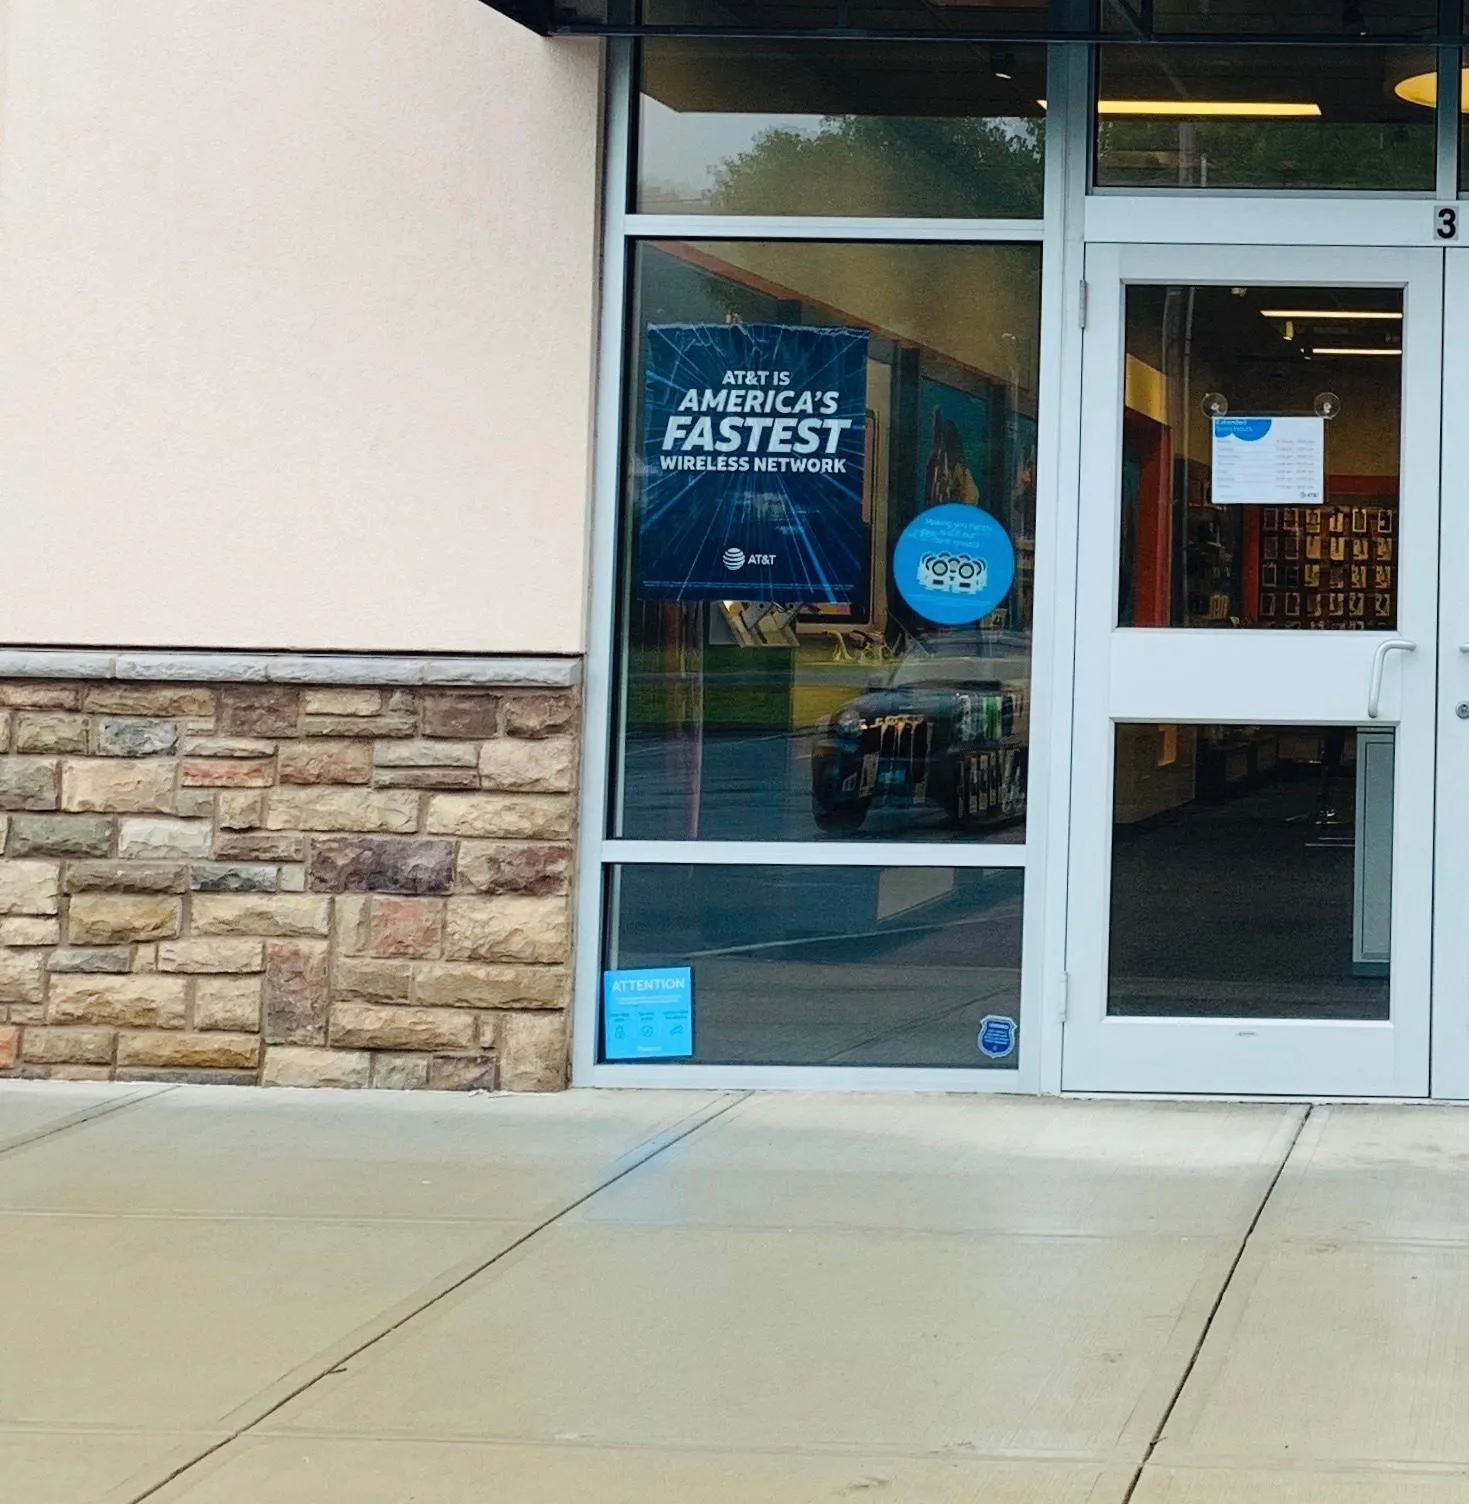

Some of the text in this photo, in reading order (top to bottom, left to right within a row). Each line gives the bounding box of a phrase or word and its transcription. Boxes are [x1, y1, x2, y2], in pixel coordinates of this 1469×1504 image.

[1437, 208, 1456, 239] 3
[722, 370, 791, 386] AT&T IS
[661, 415, 852, 454] FASTEST
[660, 455, 847, 473] WIRELESS NETWORK
[748, 554, 776, 565] AT&T
[612, 977, 685, 993] ATTENTION
